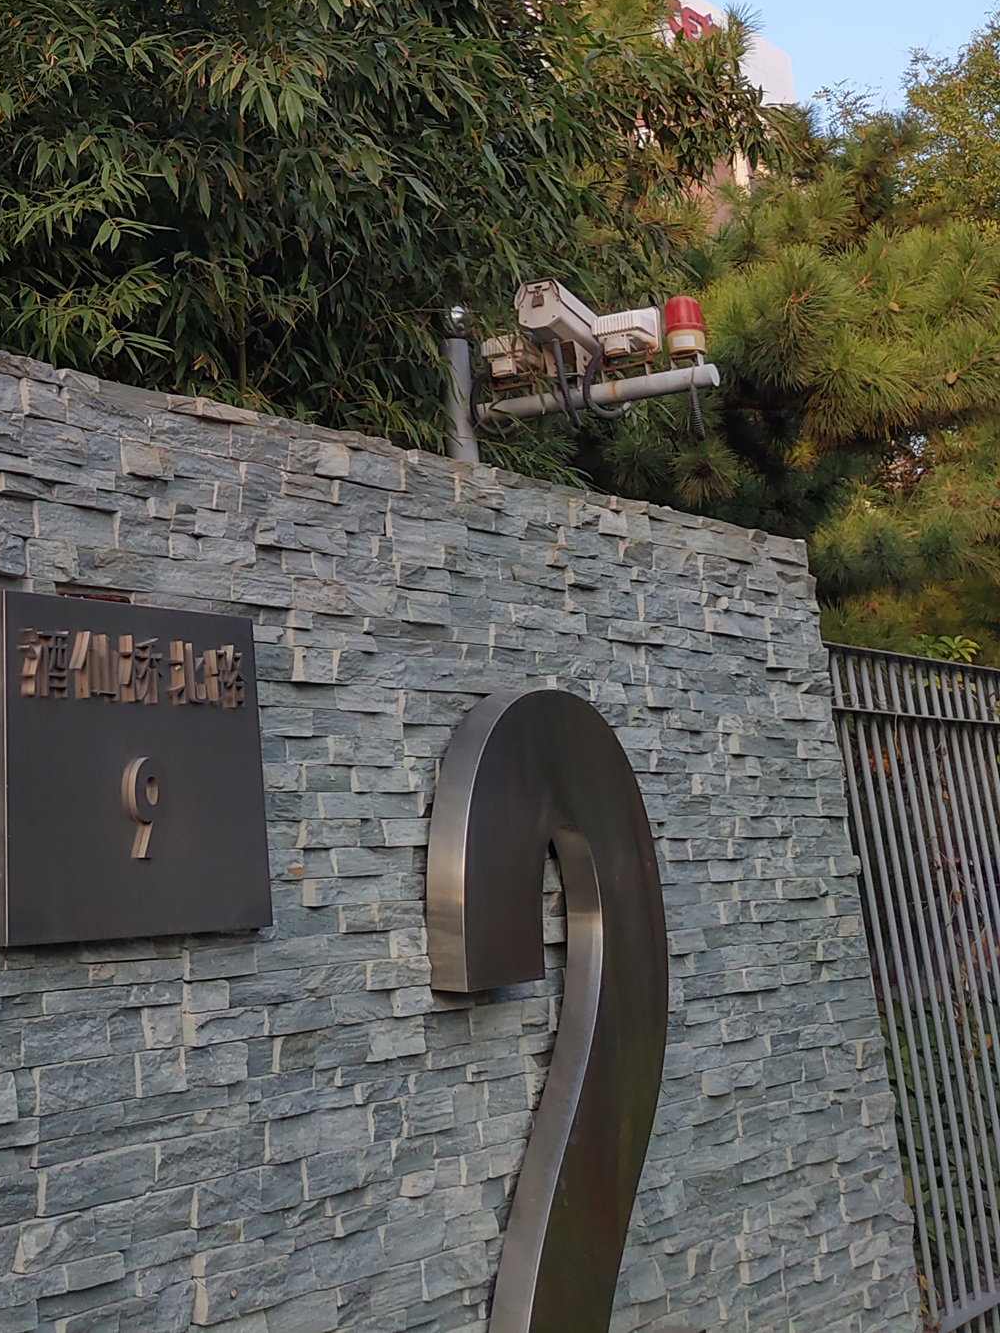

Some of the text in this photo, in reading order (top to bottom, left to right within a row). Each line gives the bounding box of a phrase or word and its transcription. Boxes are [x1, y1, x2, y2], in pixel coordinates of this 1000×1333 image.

[16, 627, 246, 709] 酒仙桥北路
[121, 755, 166, 860] 9
